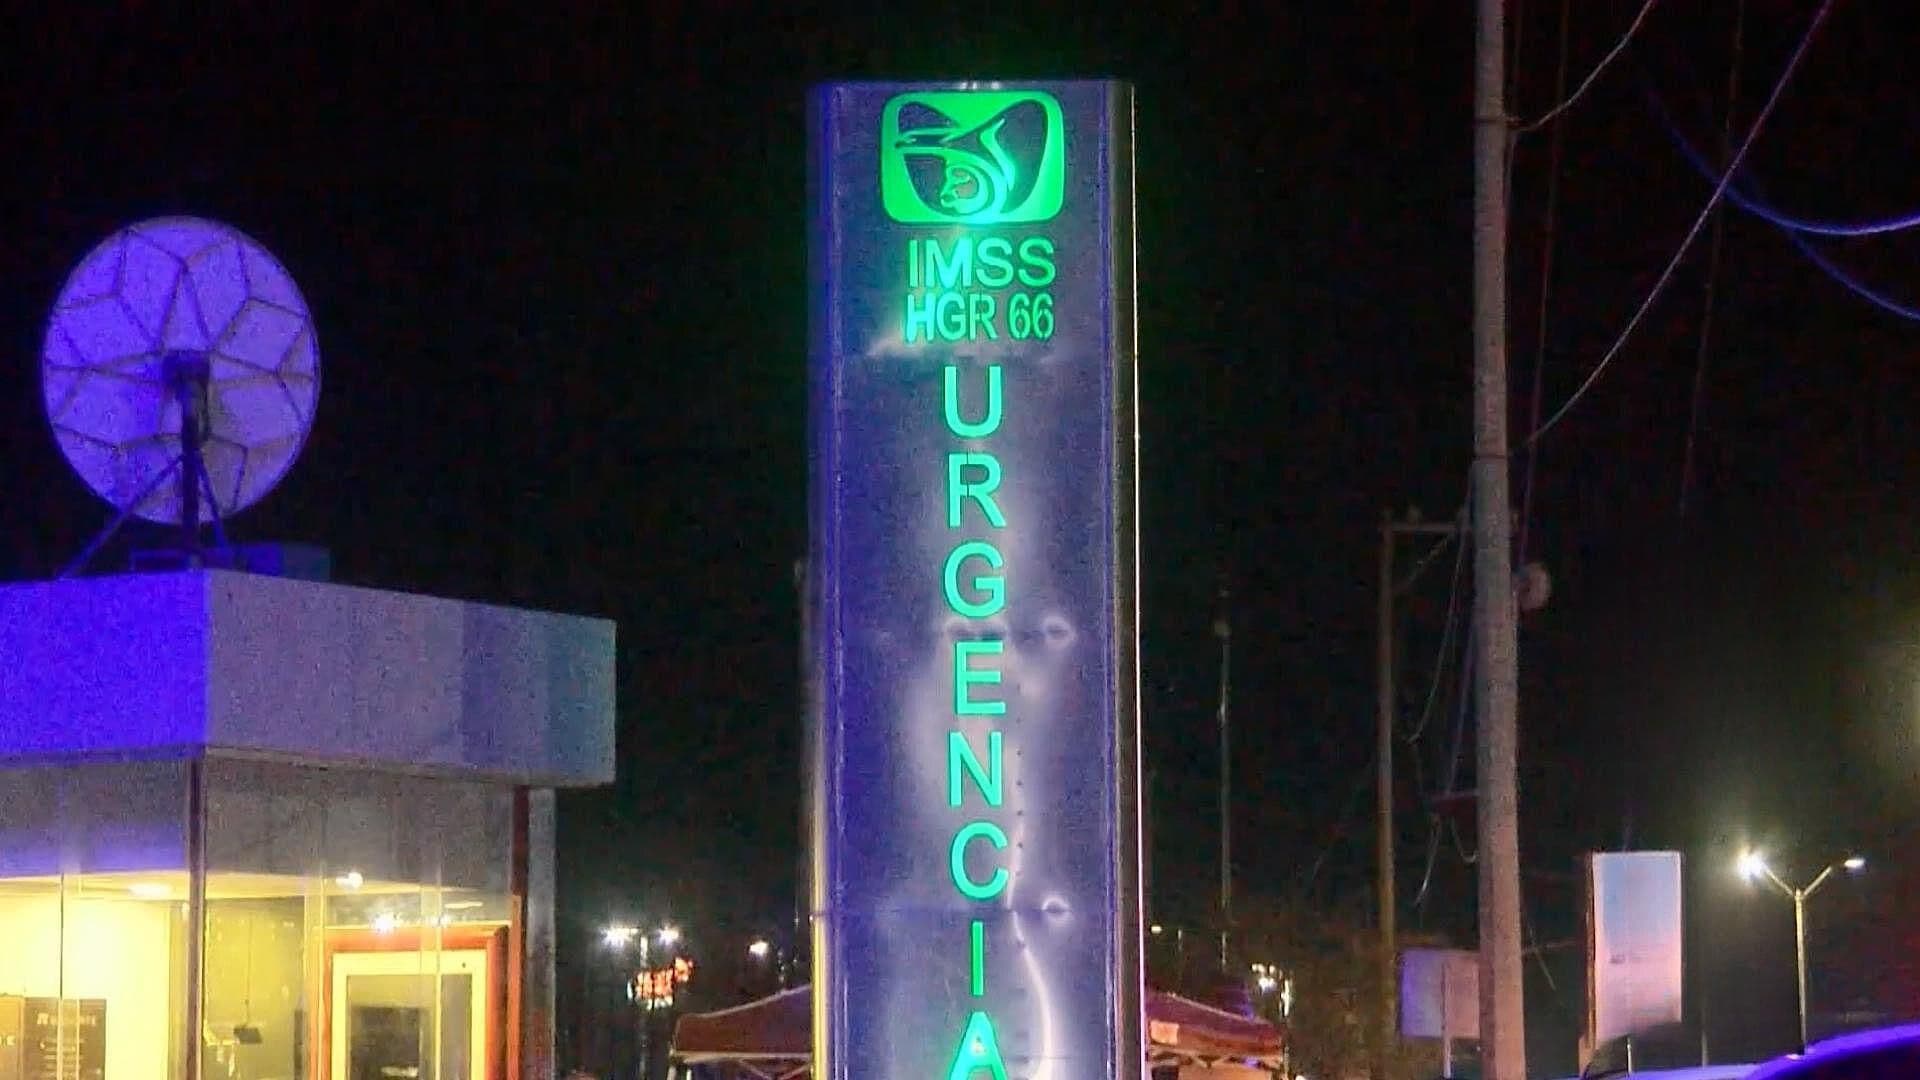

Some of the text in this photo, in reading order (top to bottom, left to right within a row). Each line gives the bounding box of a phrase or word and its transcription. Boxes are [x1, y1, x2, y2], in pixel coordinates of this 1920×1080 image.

[908, 237, 1056, 287] IMSS
[905, 293, 1055, 341] HGR 66
[943, 365, 1010, 1080] URGENCIA
